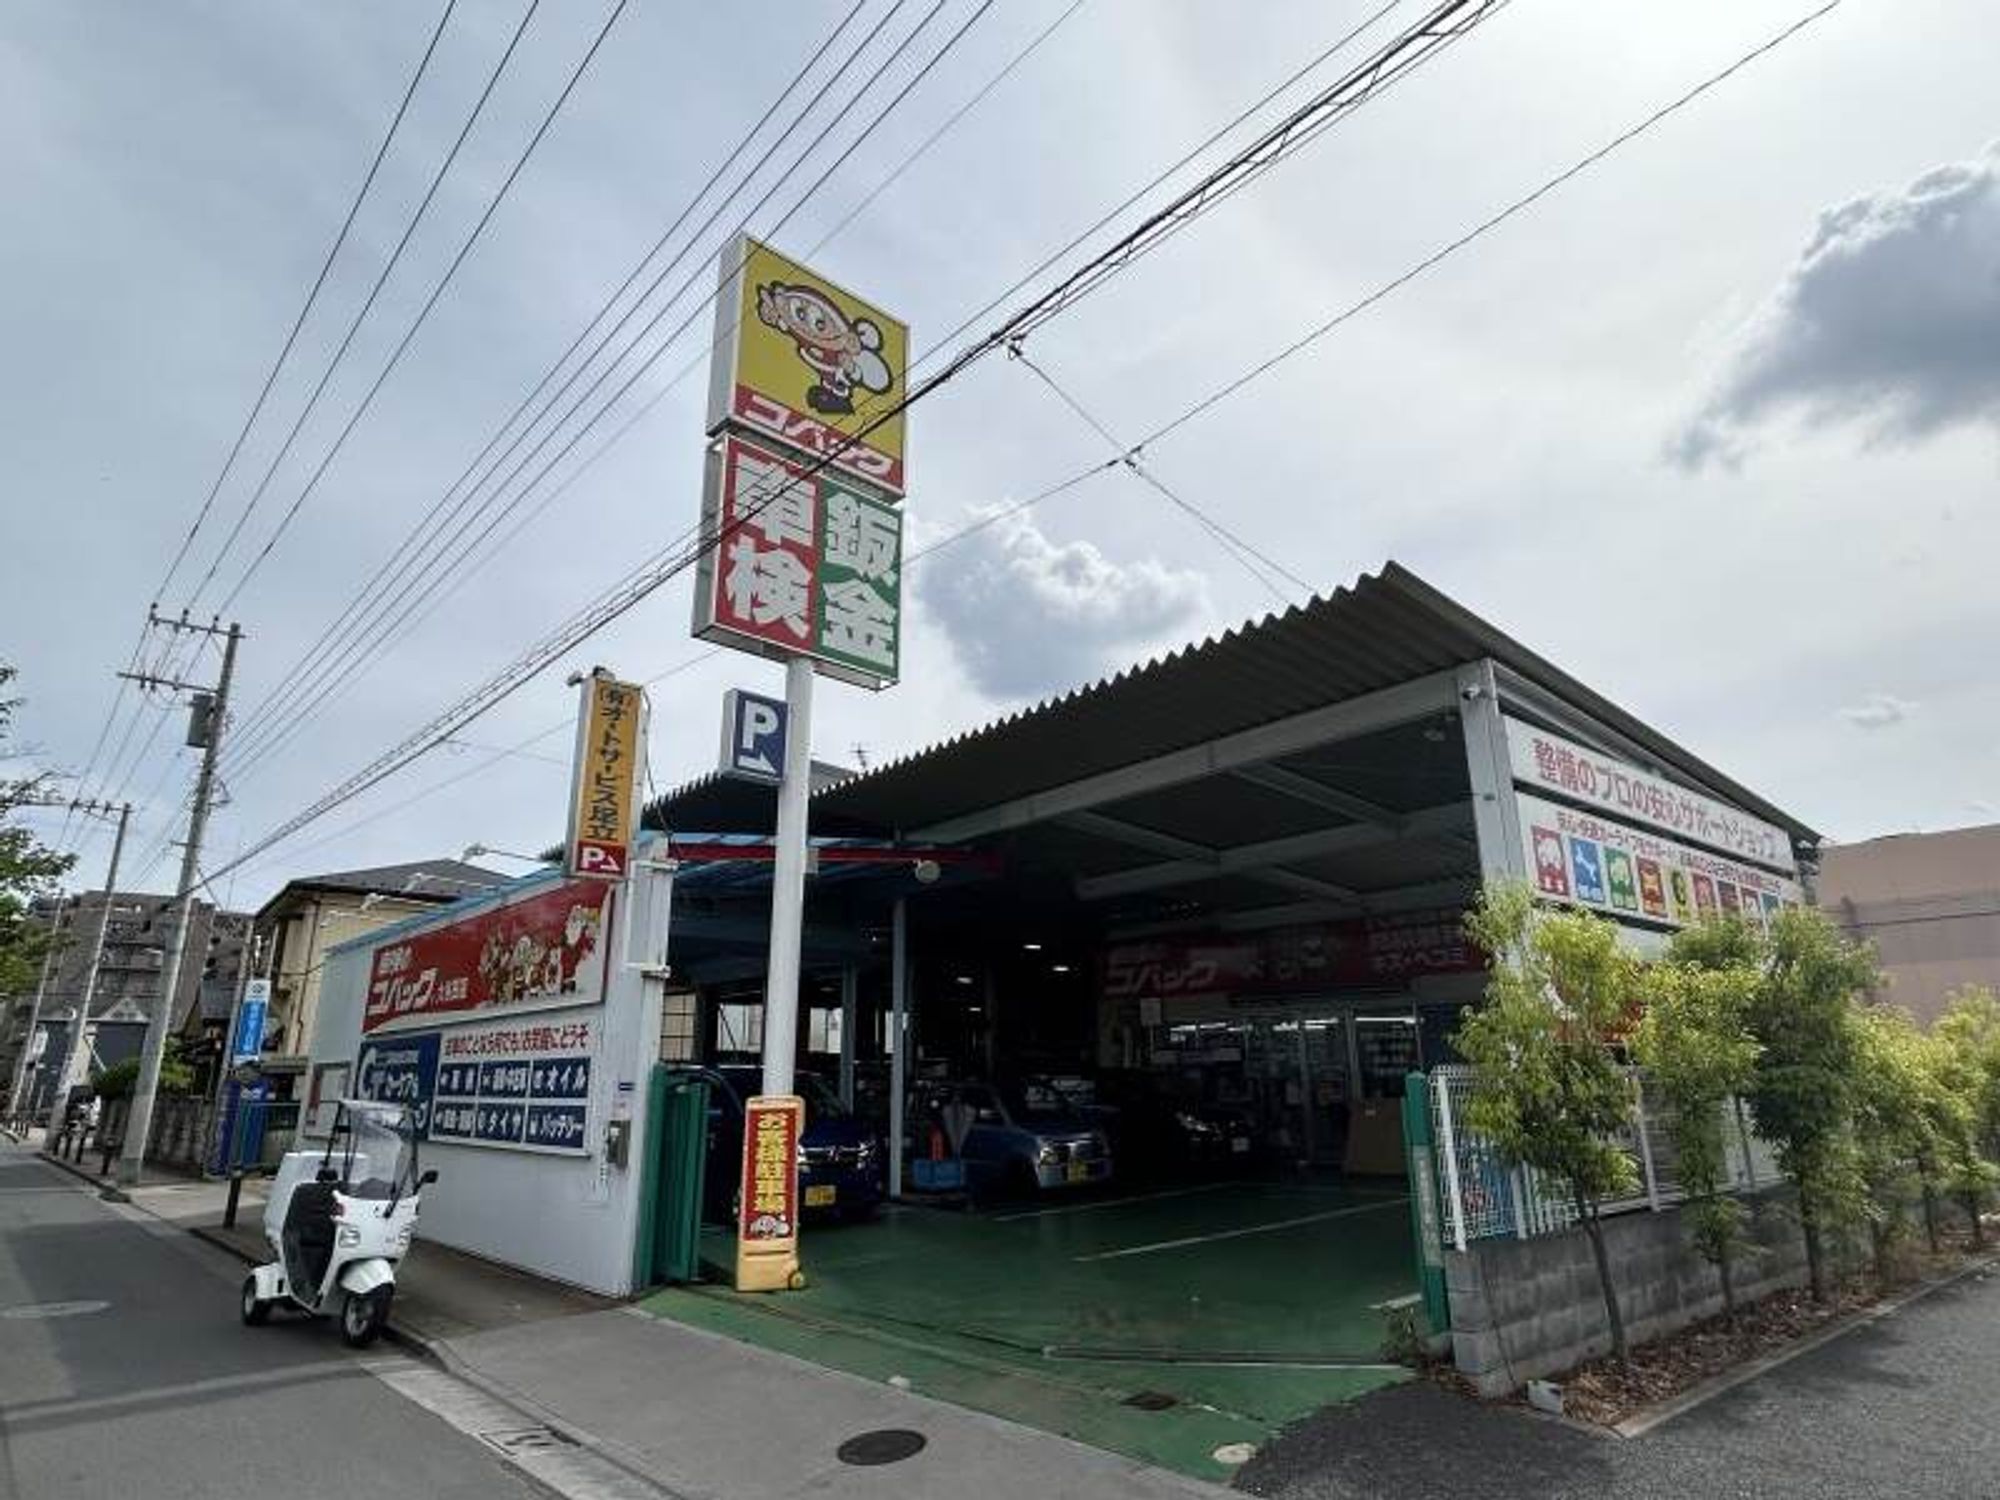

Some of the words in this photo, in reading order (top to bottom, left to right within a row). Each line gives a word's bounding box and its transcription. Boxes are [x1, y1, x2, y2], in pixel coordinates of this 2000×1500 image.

[744, 394, 893, 478] コバック
[725, 452, 816, 641] 車検
[822, 491, 900, 670] 鈑金
[742, 700, 779, 750] P
[581, 847, 605, 870] P
[367, 967, 439, 1015] コバック
[488, 1108, 523, 1136] タイヤ
[540, 1112, 584, 1139] バッテリー
